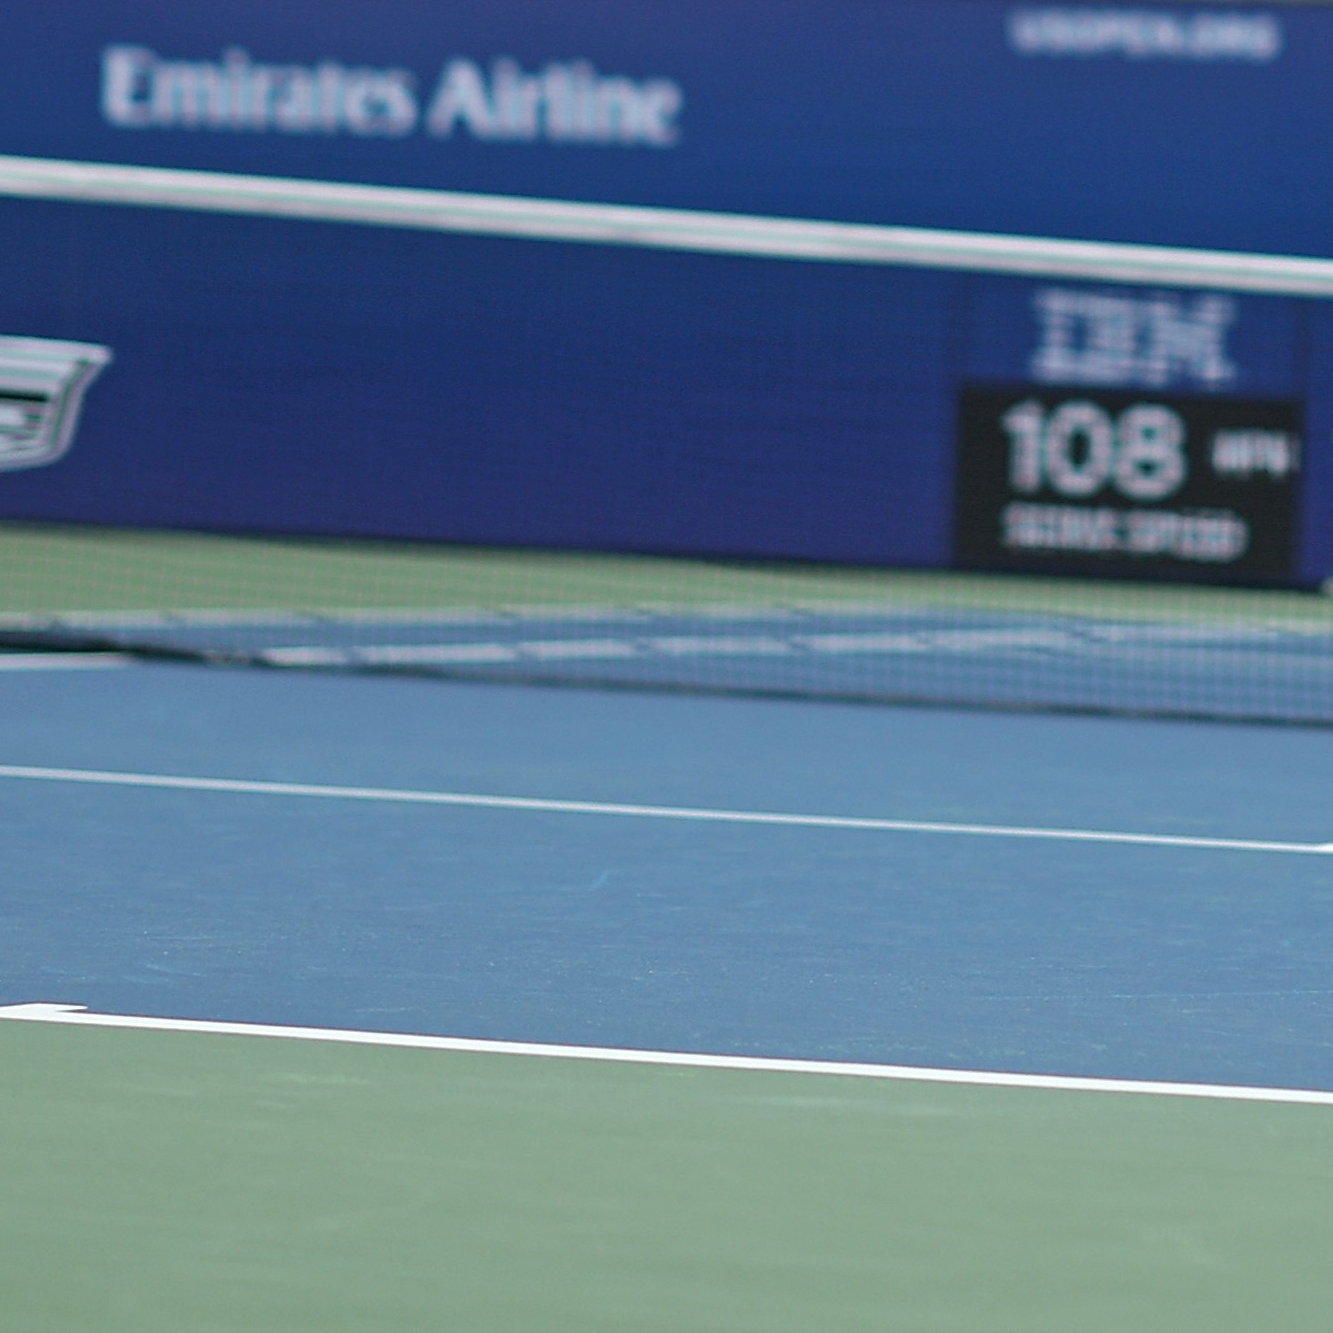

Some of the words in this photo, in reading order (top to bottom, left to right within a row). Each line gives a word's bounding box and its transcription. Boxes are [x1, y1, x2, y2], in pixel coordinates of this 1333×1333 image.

[102, 46, 416, 133] Emirates
[428, 60, 682, 144] Airline
[1003, 401, 1186, 499] 108
